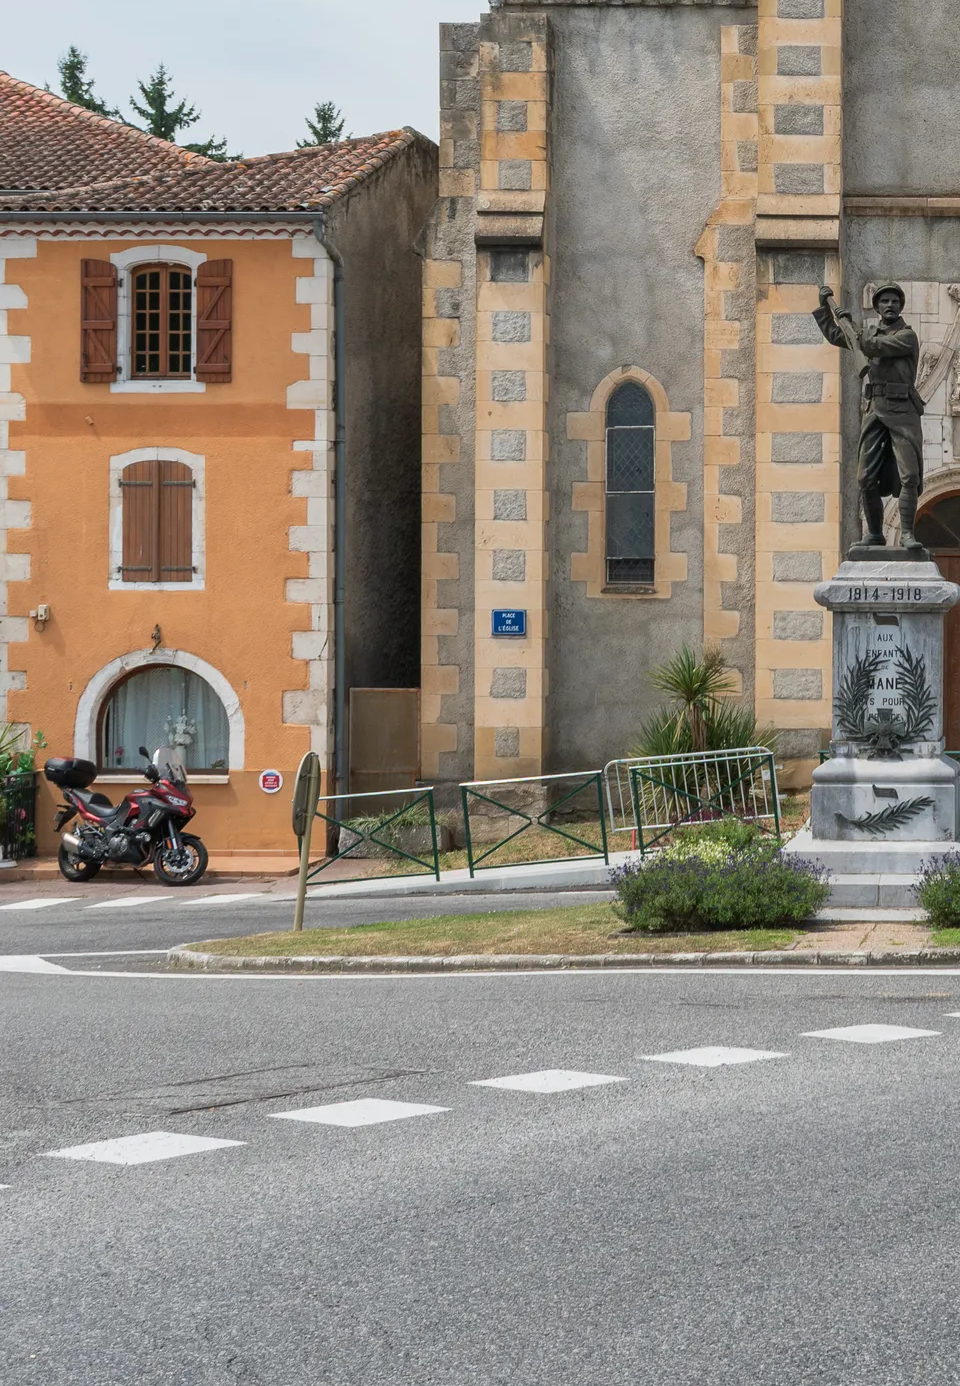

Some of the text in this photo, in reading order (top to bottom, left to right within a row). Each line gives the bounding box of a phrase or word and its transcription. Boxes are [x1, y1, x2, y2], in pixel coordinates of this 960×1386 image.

[849, 587, 922, 601] 1914-1918
[877, 633, 894, 642] AUX
[866, 649, 905, 658] ENFANTS
